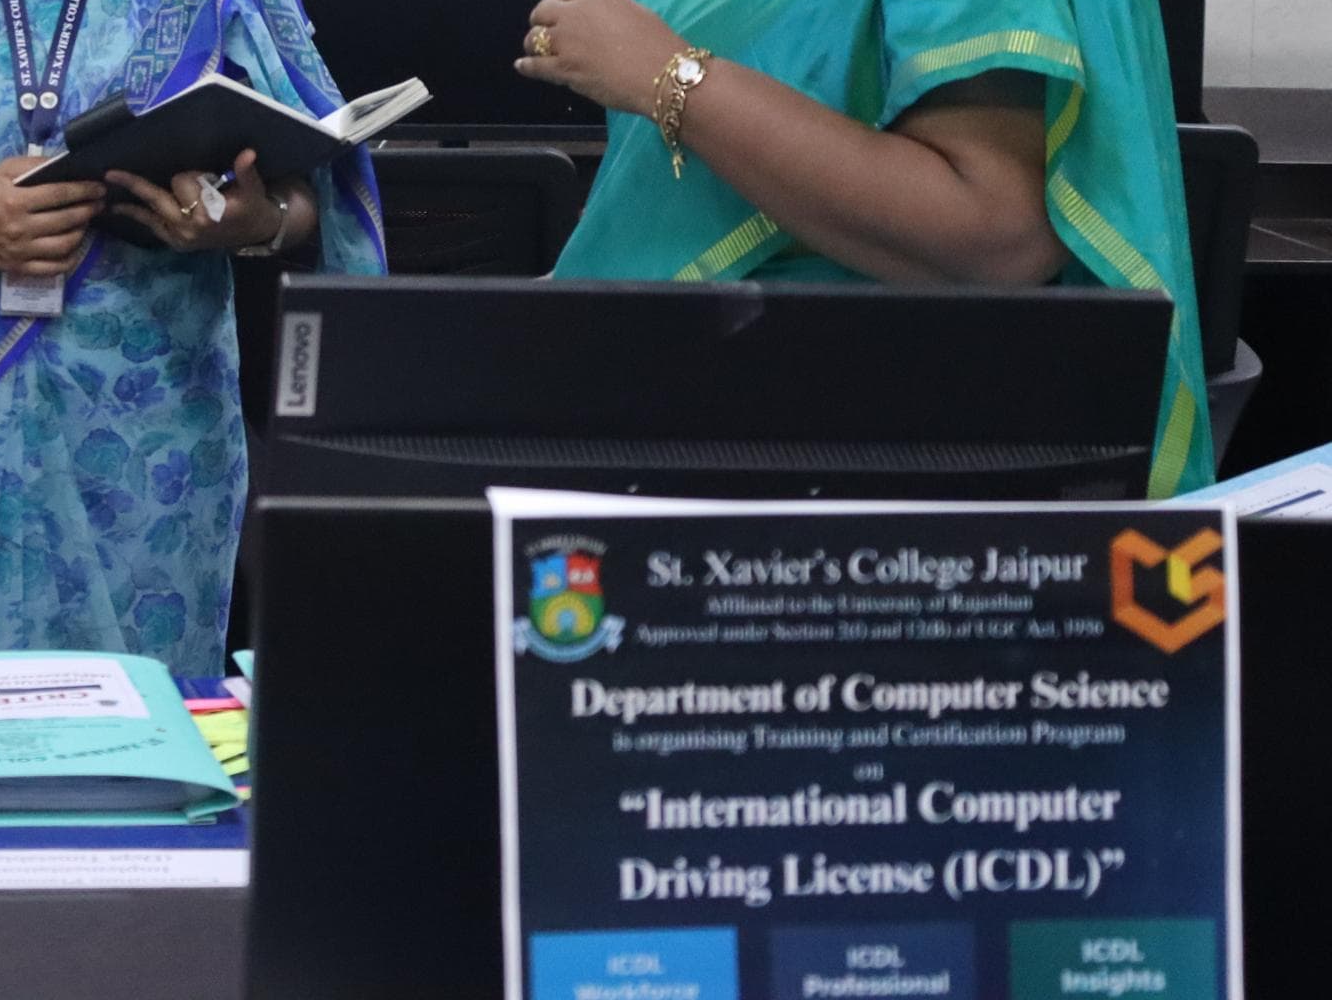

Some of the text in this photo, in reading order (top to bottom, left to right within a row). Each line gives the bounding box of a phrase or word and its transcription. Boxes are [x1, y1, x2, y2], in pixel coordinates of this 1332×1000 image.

[11, 19, 30, 69] XAVIER'S
[52, 21, 74, 70] XAVIER'S
[20, 70, 32, 86] ST.
[48, 70, 60, 87] ST.
[286, 321, 311, 408] Lenovo
[646, 546, 1088, 590] St. Xavier's College Jaipur
[787, 597, 806, 614] to
[810, 595, 835, 614] the
[838, 594, 922, 617] University
[926, 593, 946, 612] of
[949, 591, 1034, 615] Rajasthan
[636, 623, 719, 647] Approved
[721, 622, 768, 641] under
[772, 621, 834, 640] Section
[870, 620, 901, 639] and
[1064, 618, 1105, 637] 1956
[570, 669, 1169, 724] Department of Computer Science
[612, 720, 1125, 755] is organising Training and Certification Program
[853, 761, 884, 782] on
[917, 781, 1122, 832] Computer
[618, 855, 771, 907] Driving
[782, 852, 935, 896] License
[606, 952, 665, 977] ICDL
[845, 943, 906, 970] ICDL
[1080, 937, 1146, 964] ICDL
[802, 971, 951, 998] Professional
[1060, 966, 1168, 998] Insights
